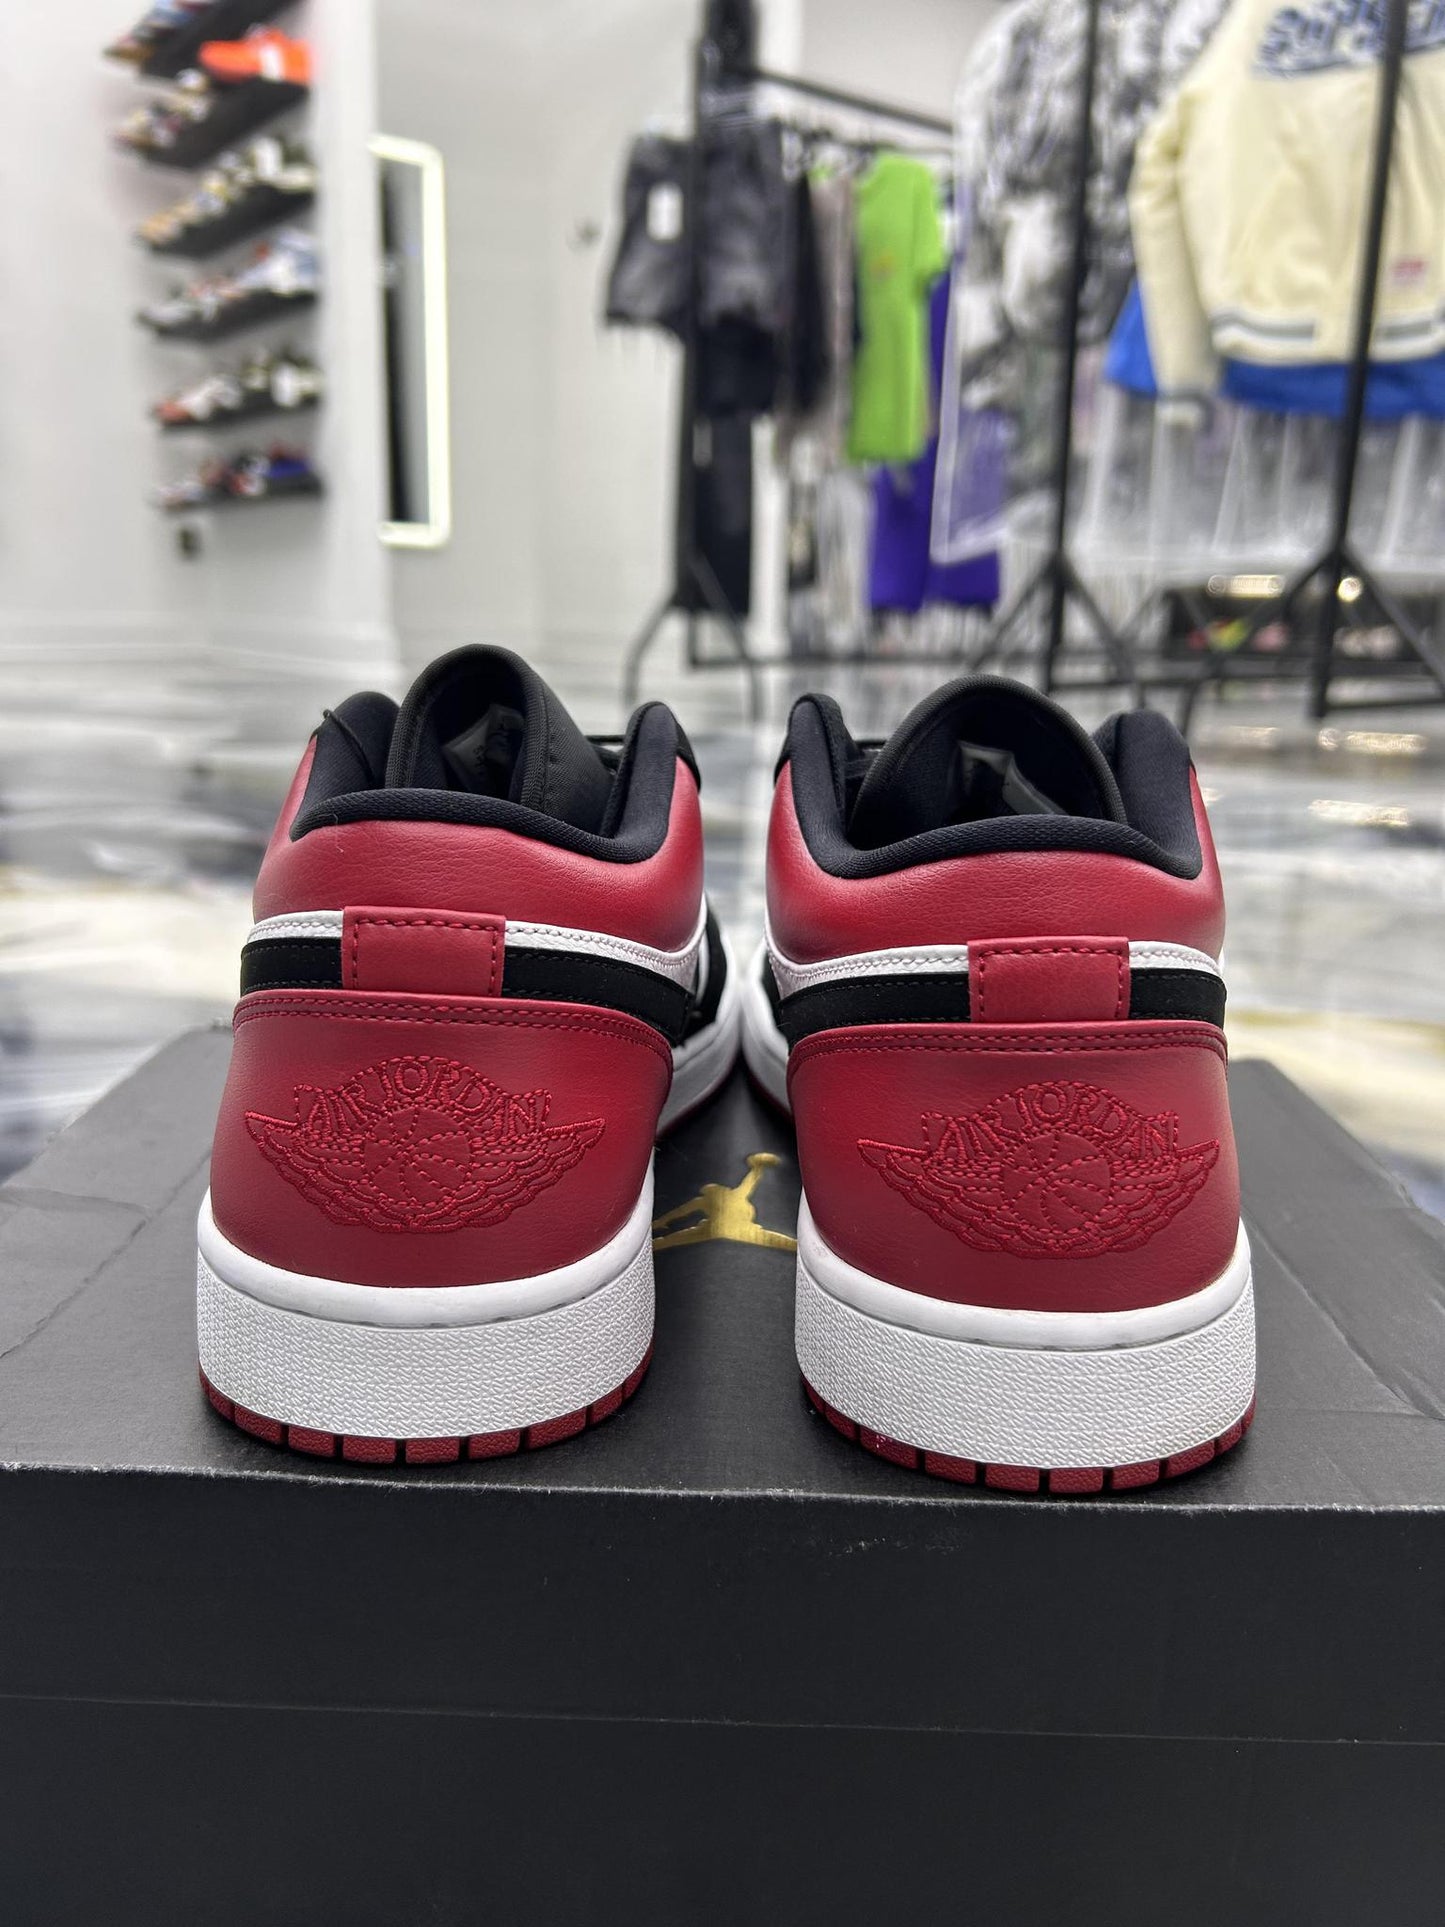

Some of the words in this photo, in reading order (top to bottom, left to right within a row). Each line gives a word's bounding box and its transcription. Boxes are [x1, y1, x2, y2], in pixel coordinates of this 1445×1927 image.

[303, 1082, 384, 1135] AIR
[378, 1058, 541, 1135] JORDAN
[934, 1110, 1023, 1161] AIR
[1014, 1083, 1174, 1160] JORDAN
